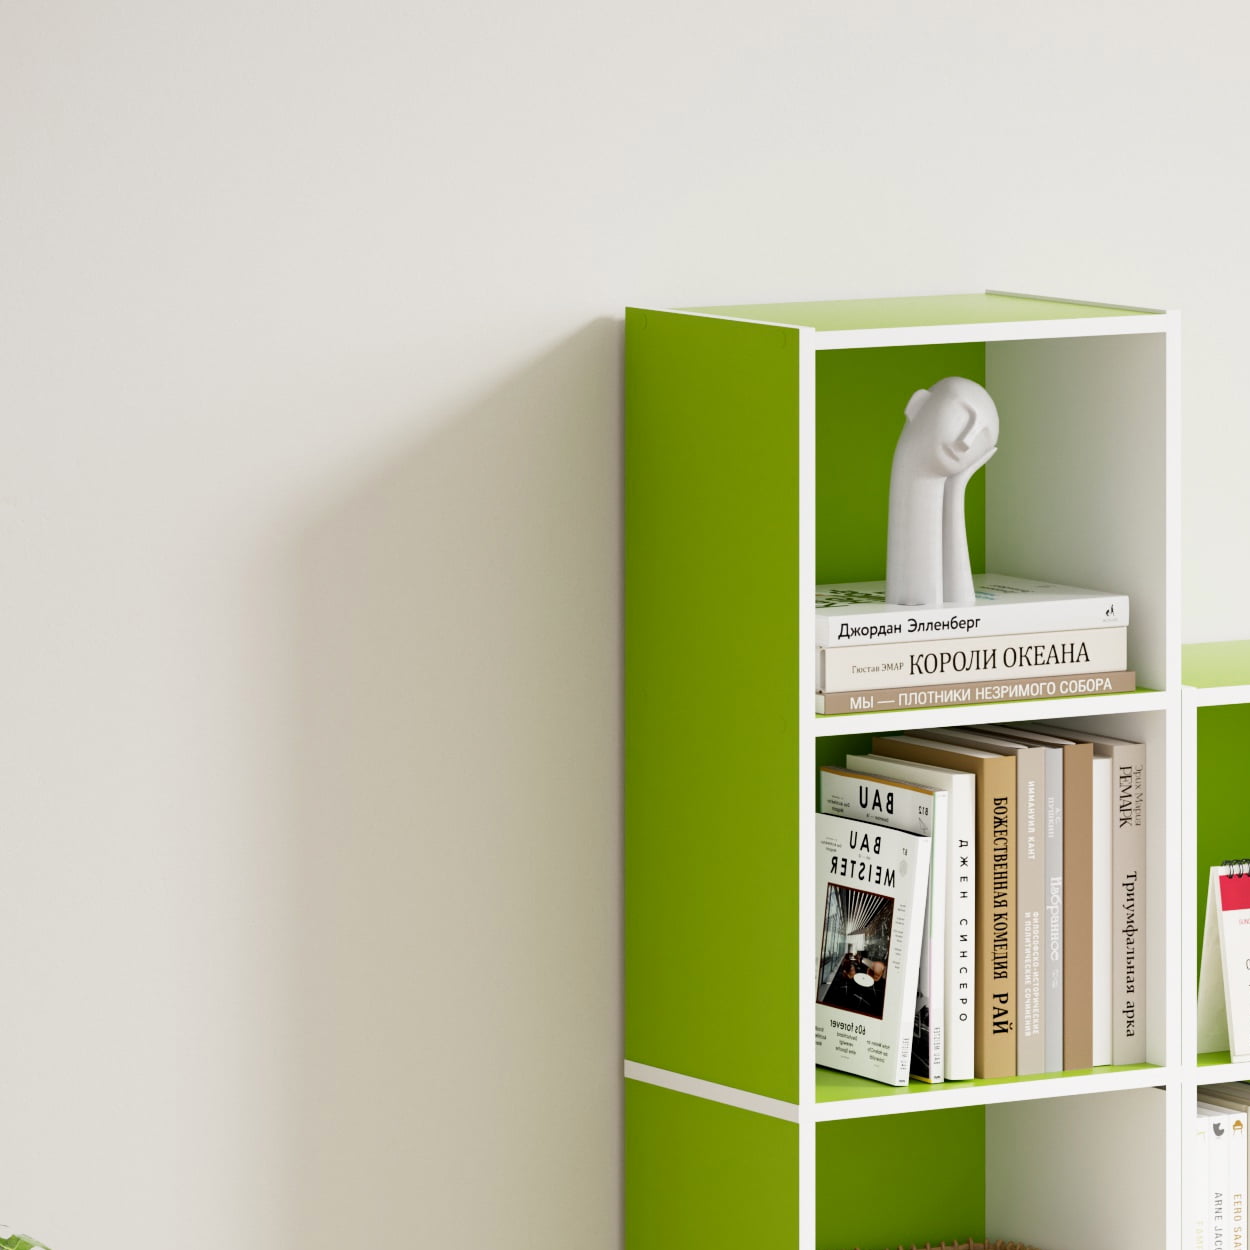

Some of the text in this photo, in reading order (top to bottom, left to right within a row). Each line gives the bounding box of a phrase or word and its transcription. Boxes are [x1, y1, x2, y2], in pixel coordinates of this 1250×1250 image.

[838, 616, 981, 640] Джордан Элленберг
[909, 652, 998, 676] КОРОЛИ
[1003, 641, 1090, 668] ОКЕАНА
[850, 678, 1113, 710] МЫ ПЛОТНИКИ НЕЗРИМОГО СОБОРА
[1119, 766, 1133, 829] РЕМАРК
[1027, 836, 1036, 860] КАНТ
[992, 797, 1008, 980] БОЖЕСТВЕННАЯ КОМЕДИЯ
[958, 839, 969, 1022] ДЖЕН СИНСЕРО
[1122, 871, 1139, 1038] Триумфальная арка
[992, 992, 1013, 1035] РАЙ
[1213, 1191, 1223, 1222] ARNE
[1232, 1193, 1242, 1221] EERO
